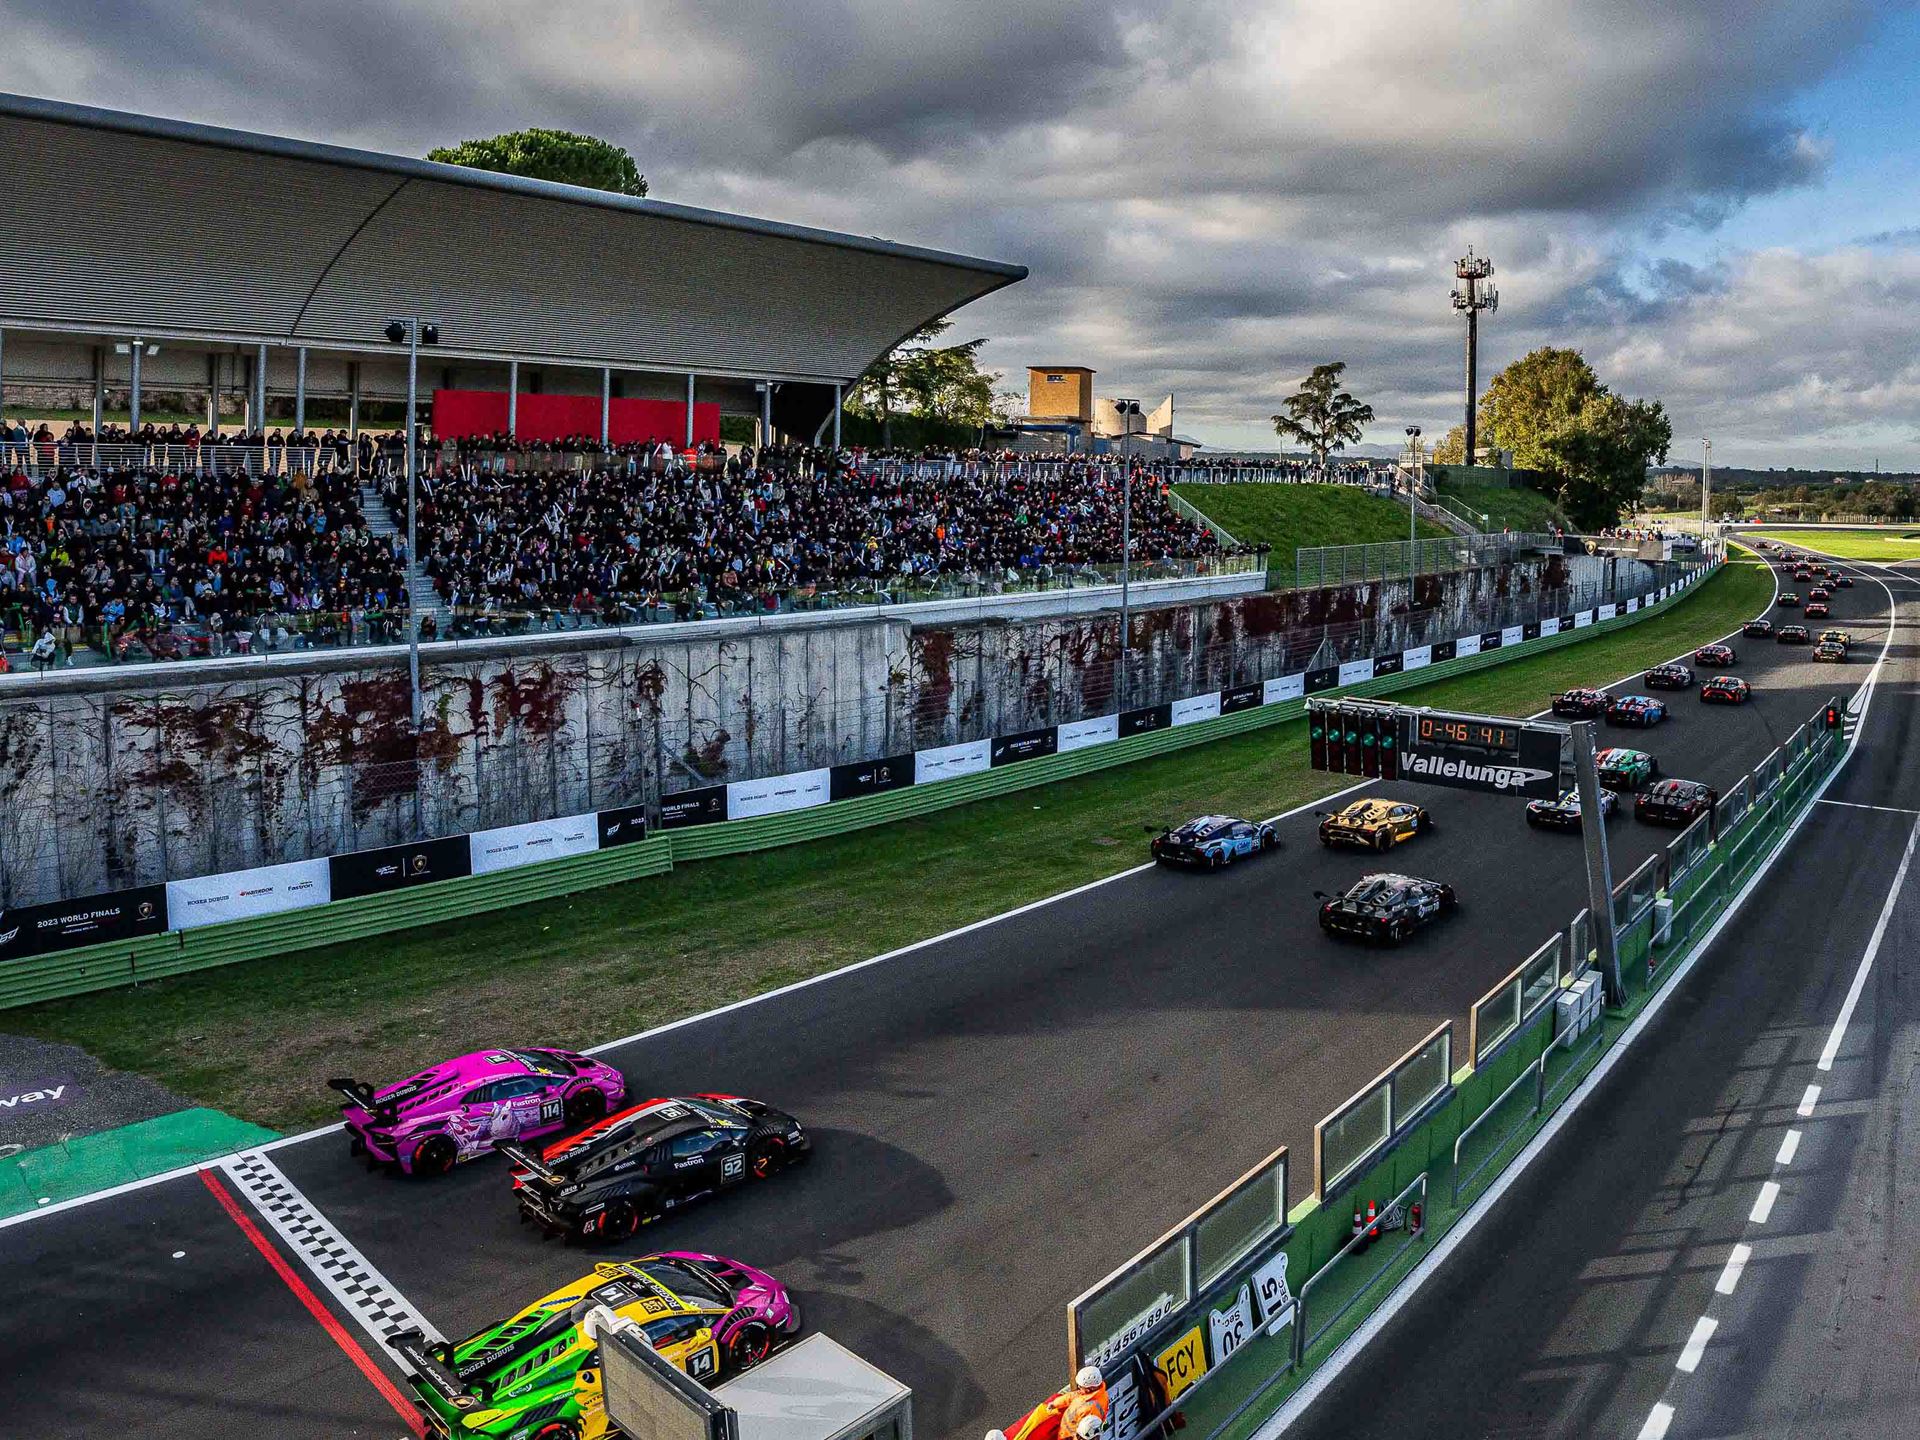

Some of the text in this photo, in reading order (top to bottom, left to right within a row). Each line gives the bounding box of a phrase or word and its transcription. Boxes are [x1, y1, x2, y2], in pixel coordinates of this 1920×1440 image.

[1481, 728, 1505, 745] 41
[1401, 752, 1526, 789] Vallelunga
[681, 801, 700, 810] FINALS
[37, 907, 121, 929] 2023 WORLD FINALS
[512, 1097, 541, 1108] Fastron
[543, 1102, 560, 1119] 114
[548, 1145, 591, 1168] ROGER DUBUIS
[674, 1157, 705, 1170] Fastron
[724, 1160, 742, 1177] 92
[600, 1287, 625, 1302] 14
[618, 1265, 681, 1309] ROGER DUBUIS
[1261, 1277, 1282, 1316] 15
[458, 1343, 516, 1379] ROGER DUBUIS
[692, 1353, 711, 1376] 14
[1166, 1339, 1195, 1388] FCY
